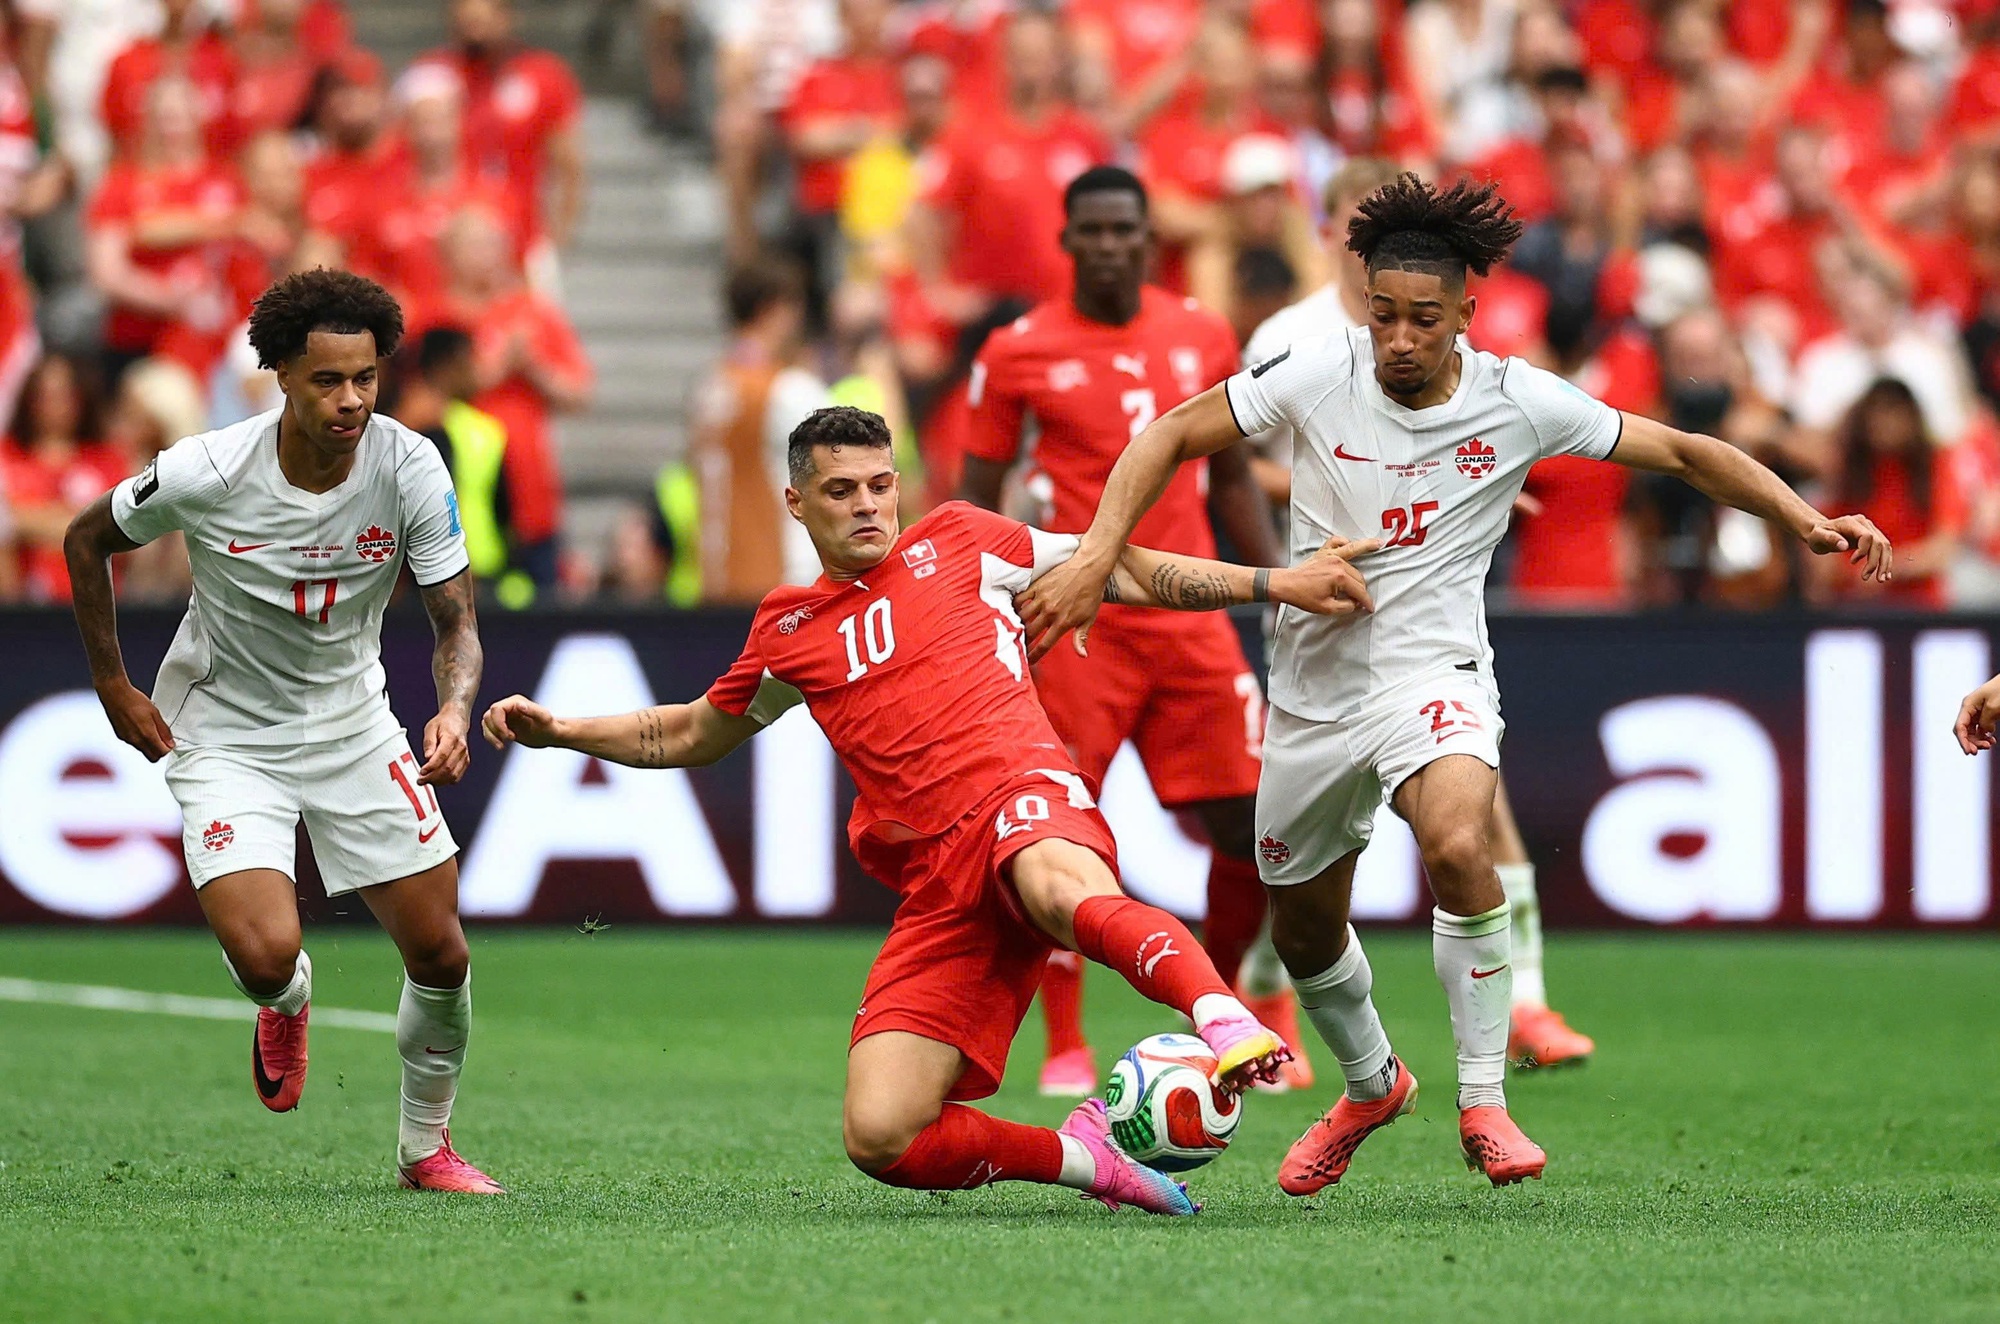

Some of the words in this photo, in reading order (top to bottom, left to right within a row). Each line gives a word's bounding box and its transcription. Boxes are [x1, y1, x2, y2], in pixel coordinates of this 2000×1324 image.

[1454, 455, 1497, 464] CANADA
[1381, 500, 1439, 547] 25
[355, 540, 396, 551] CANADA
[290, 578, 339, 624] 17
[836, 595, 897, 682] 10
[1419, 699, 1485, 733] 25
[1580, 628, 1973, 924] all
[202, 830, 235, 843] CANADA
